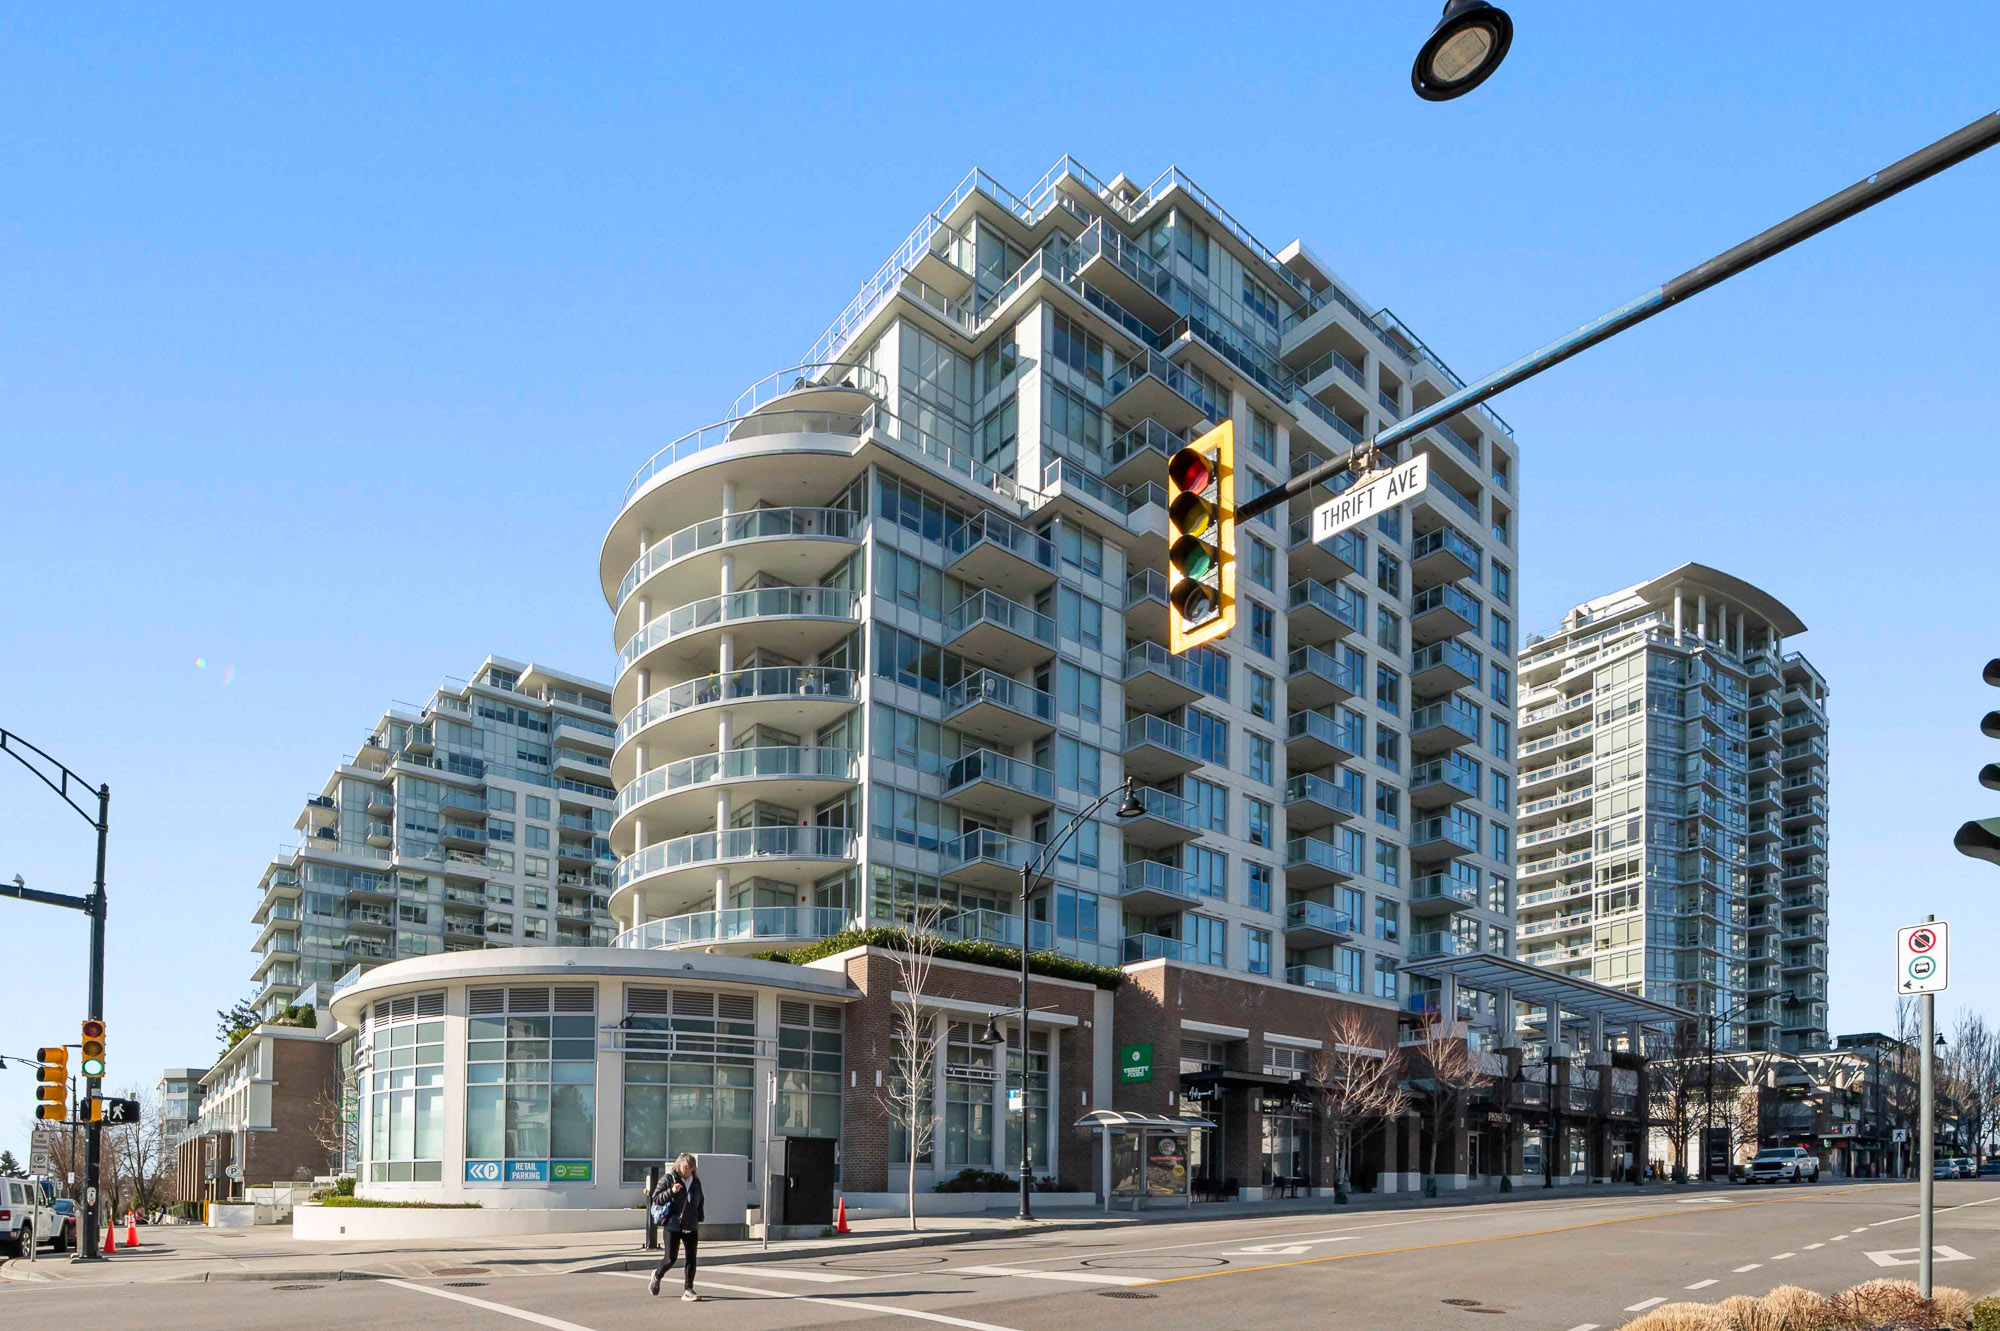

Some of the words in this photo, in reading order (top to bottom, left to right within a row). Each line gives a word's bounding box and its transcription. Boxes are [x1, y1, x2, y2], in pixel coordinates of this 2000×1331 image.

[1322, 486, 1375, 531] THRIFT
[1387, 465, 1418, 500] AVE
[488, 1165, 495, 1177] P
[515, 1162, 537, 1170] RETAIL
[512, 1171, 540, 1180] PARKING
